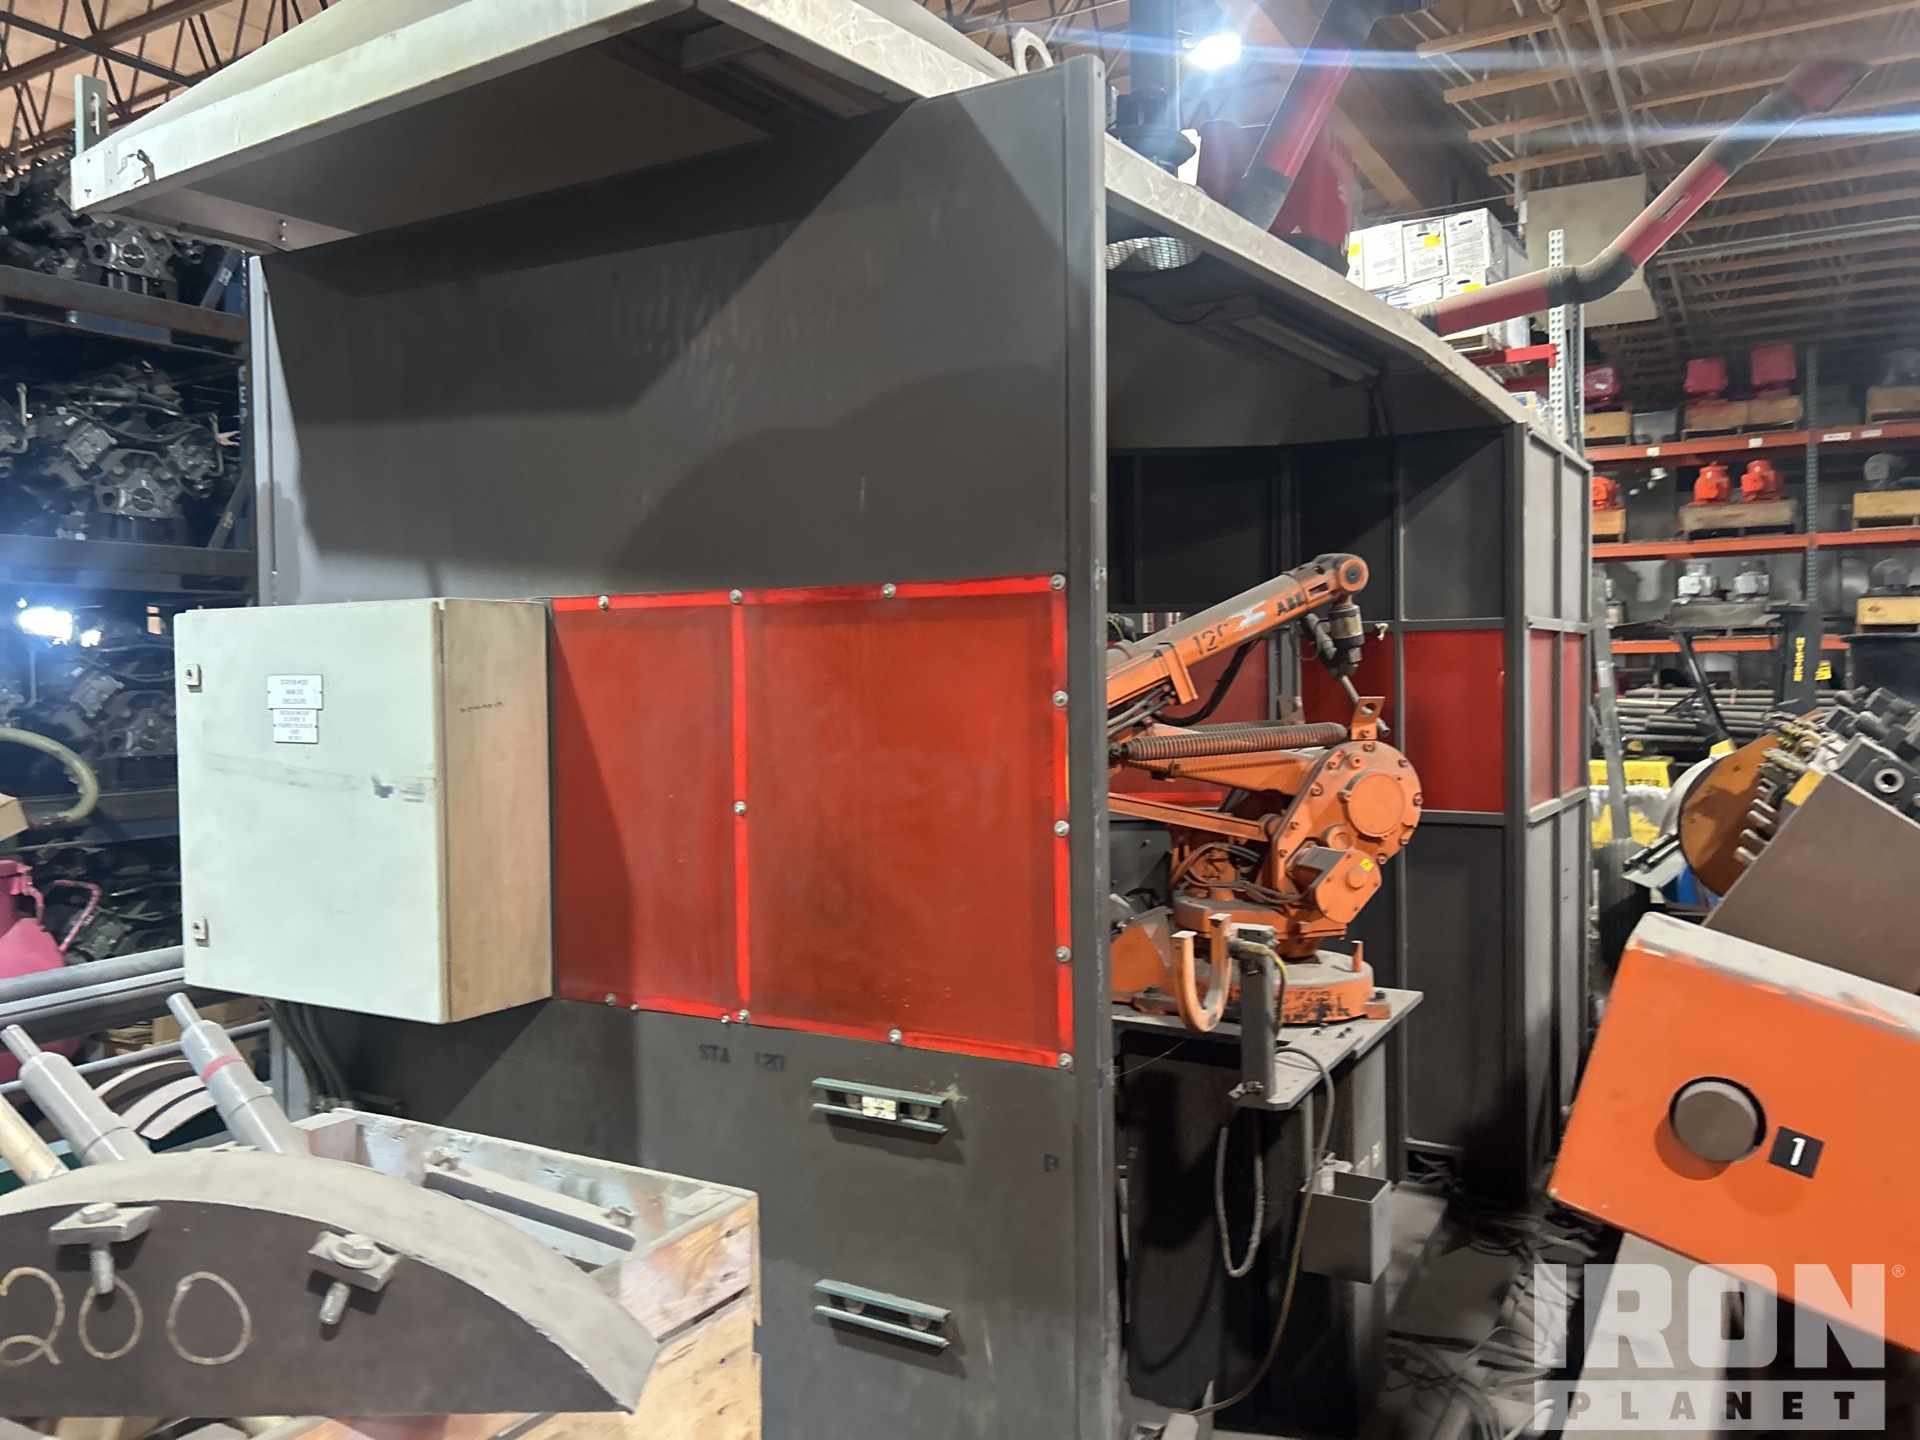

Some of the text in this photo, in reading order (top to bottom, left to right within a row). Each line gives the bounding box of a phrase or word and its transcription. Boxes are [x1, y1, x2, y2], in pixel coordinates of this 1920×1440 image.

[699, 1044, 731, 1063] STA
[1790, 1136, 1807, 1167] 1
[0, 1266, 252, 1366] 200
